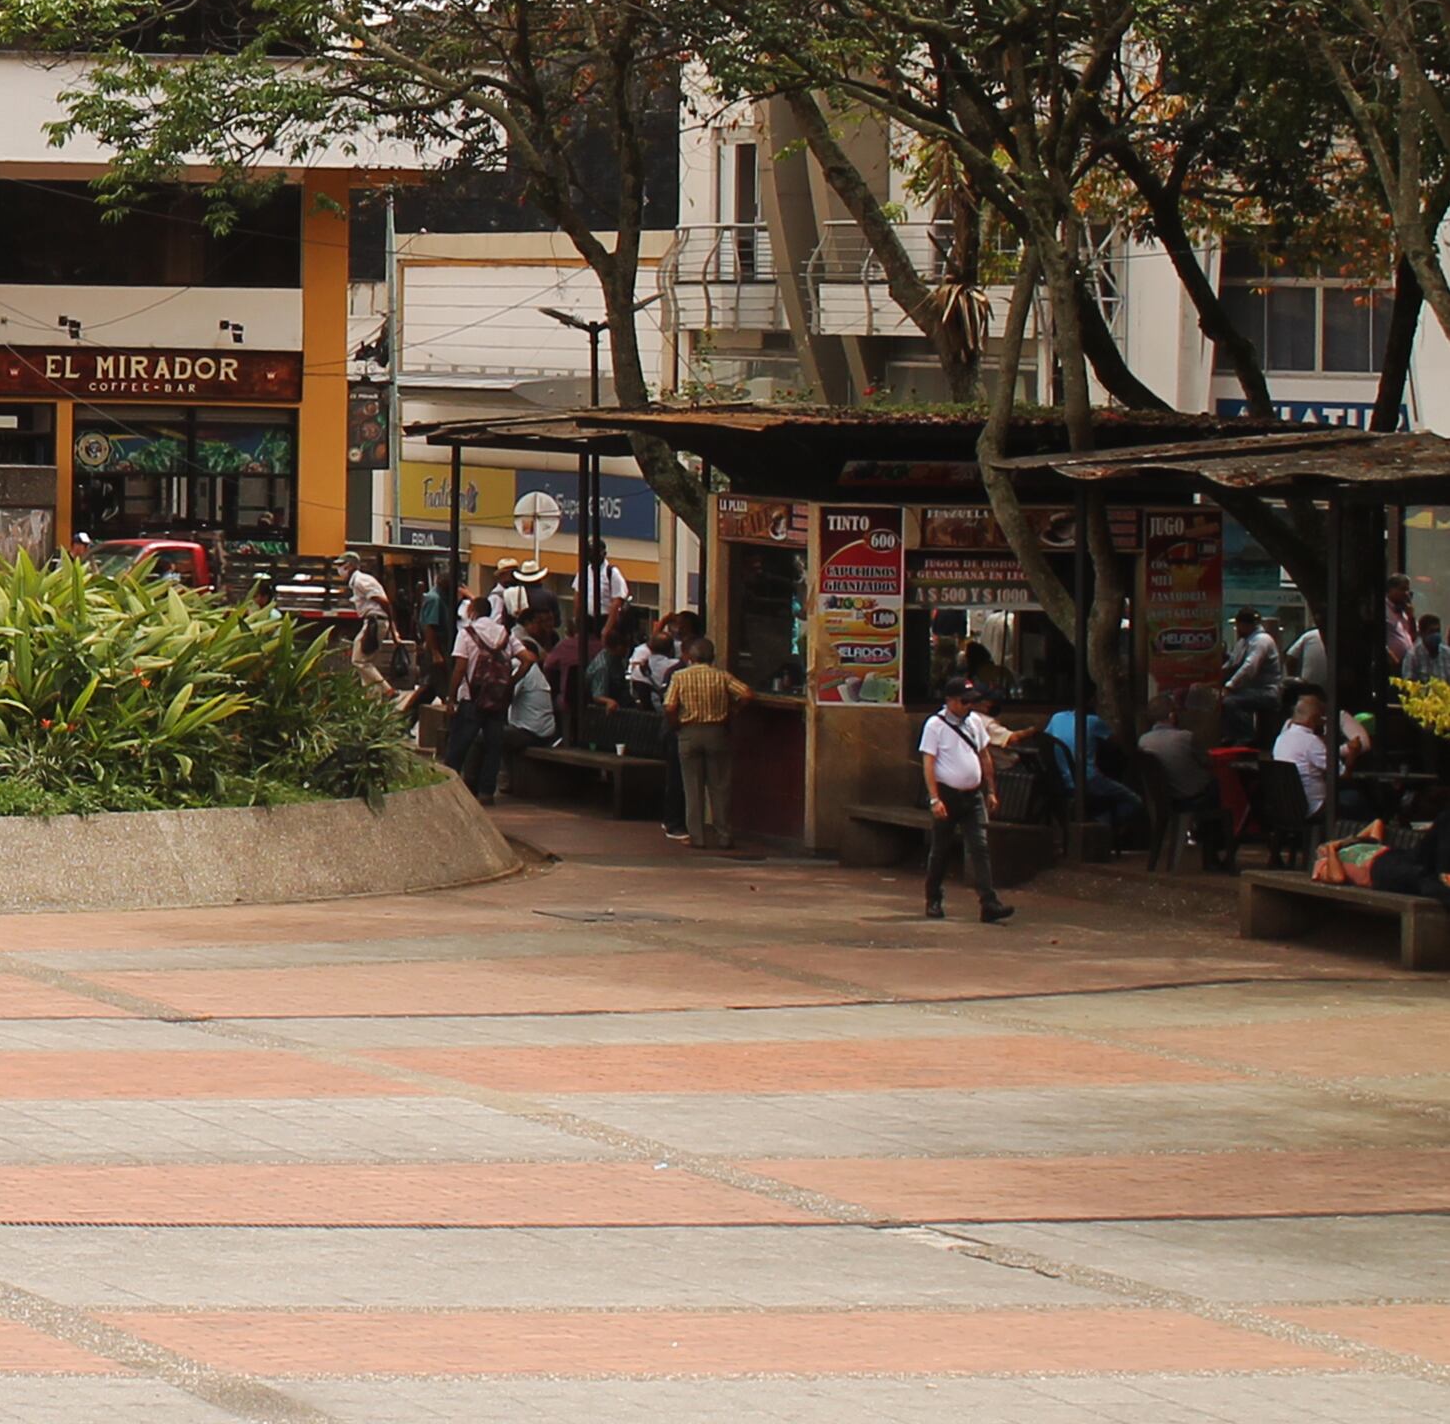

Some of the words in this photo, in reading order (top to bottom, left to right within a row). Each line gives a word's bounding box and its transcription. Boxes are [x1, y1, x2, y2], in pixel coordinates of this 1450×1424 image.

[45, 354, 81, 379] EL
[95, 355, 239, 382] MIRADOR
[827, 515, 870, 532] TINTO
[1150, 516, 1185, 538] JUGO
[870, 535, 896, 548] 600
[824, 566, 897, 578] CAPUCHINOS
[823, 580, 897, 593] GRANIZADOS
[940, 587, 968, 603] 500
